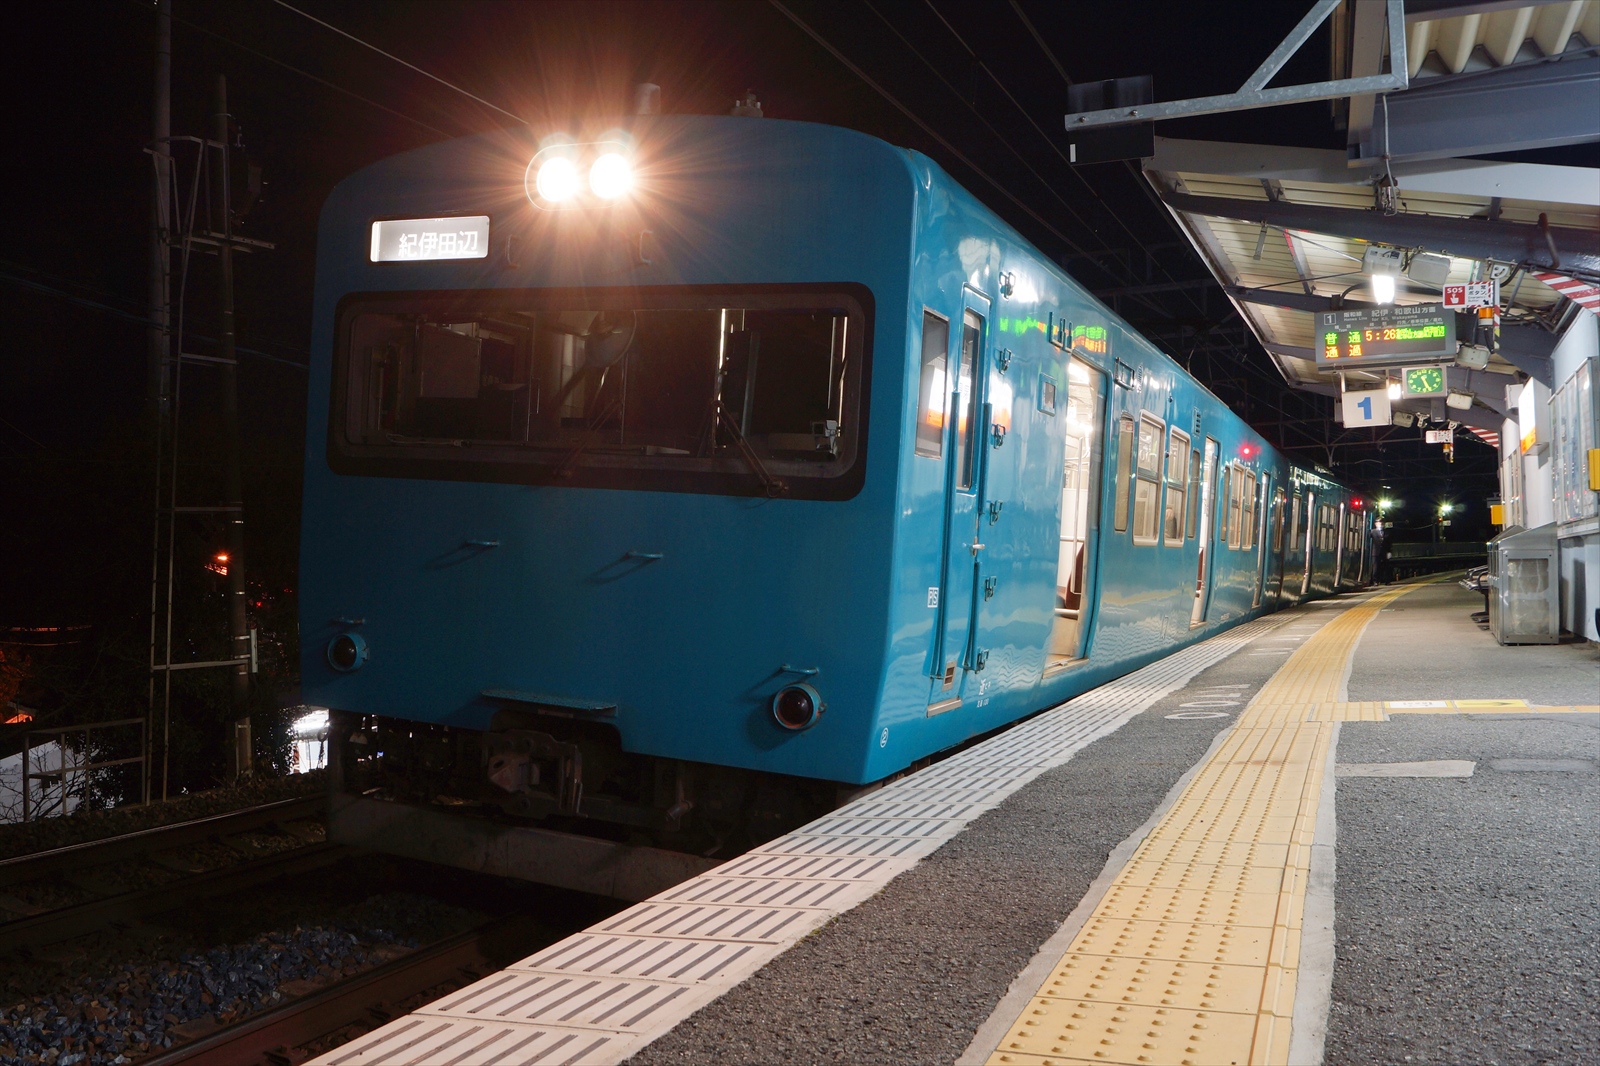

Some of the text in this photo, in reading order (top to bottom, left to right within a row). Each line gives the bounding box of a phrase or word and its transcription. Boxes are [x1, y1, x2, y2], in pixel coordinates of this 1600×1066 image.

[398, 231, 479, 258] 紀伊田辺
[1357, 397, 1372, 420] 1
